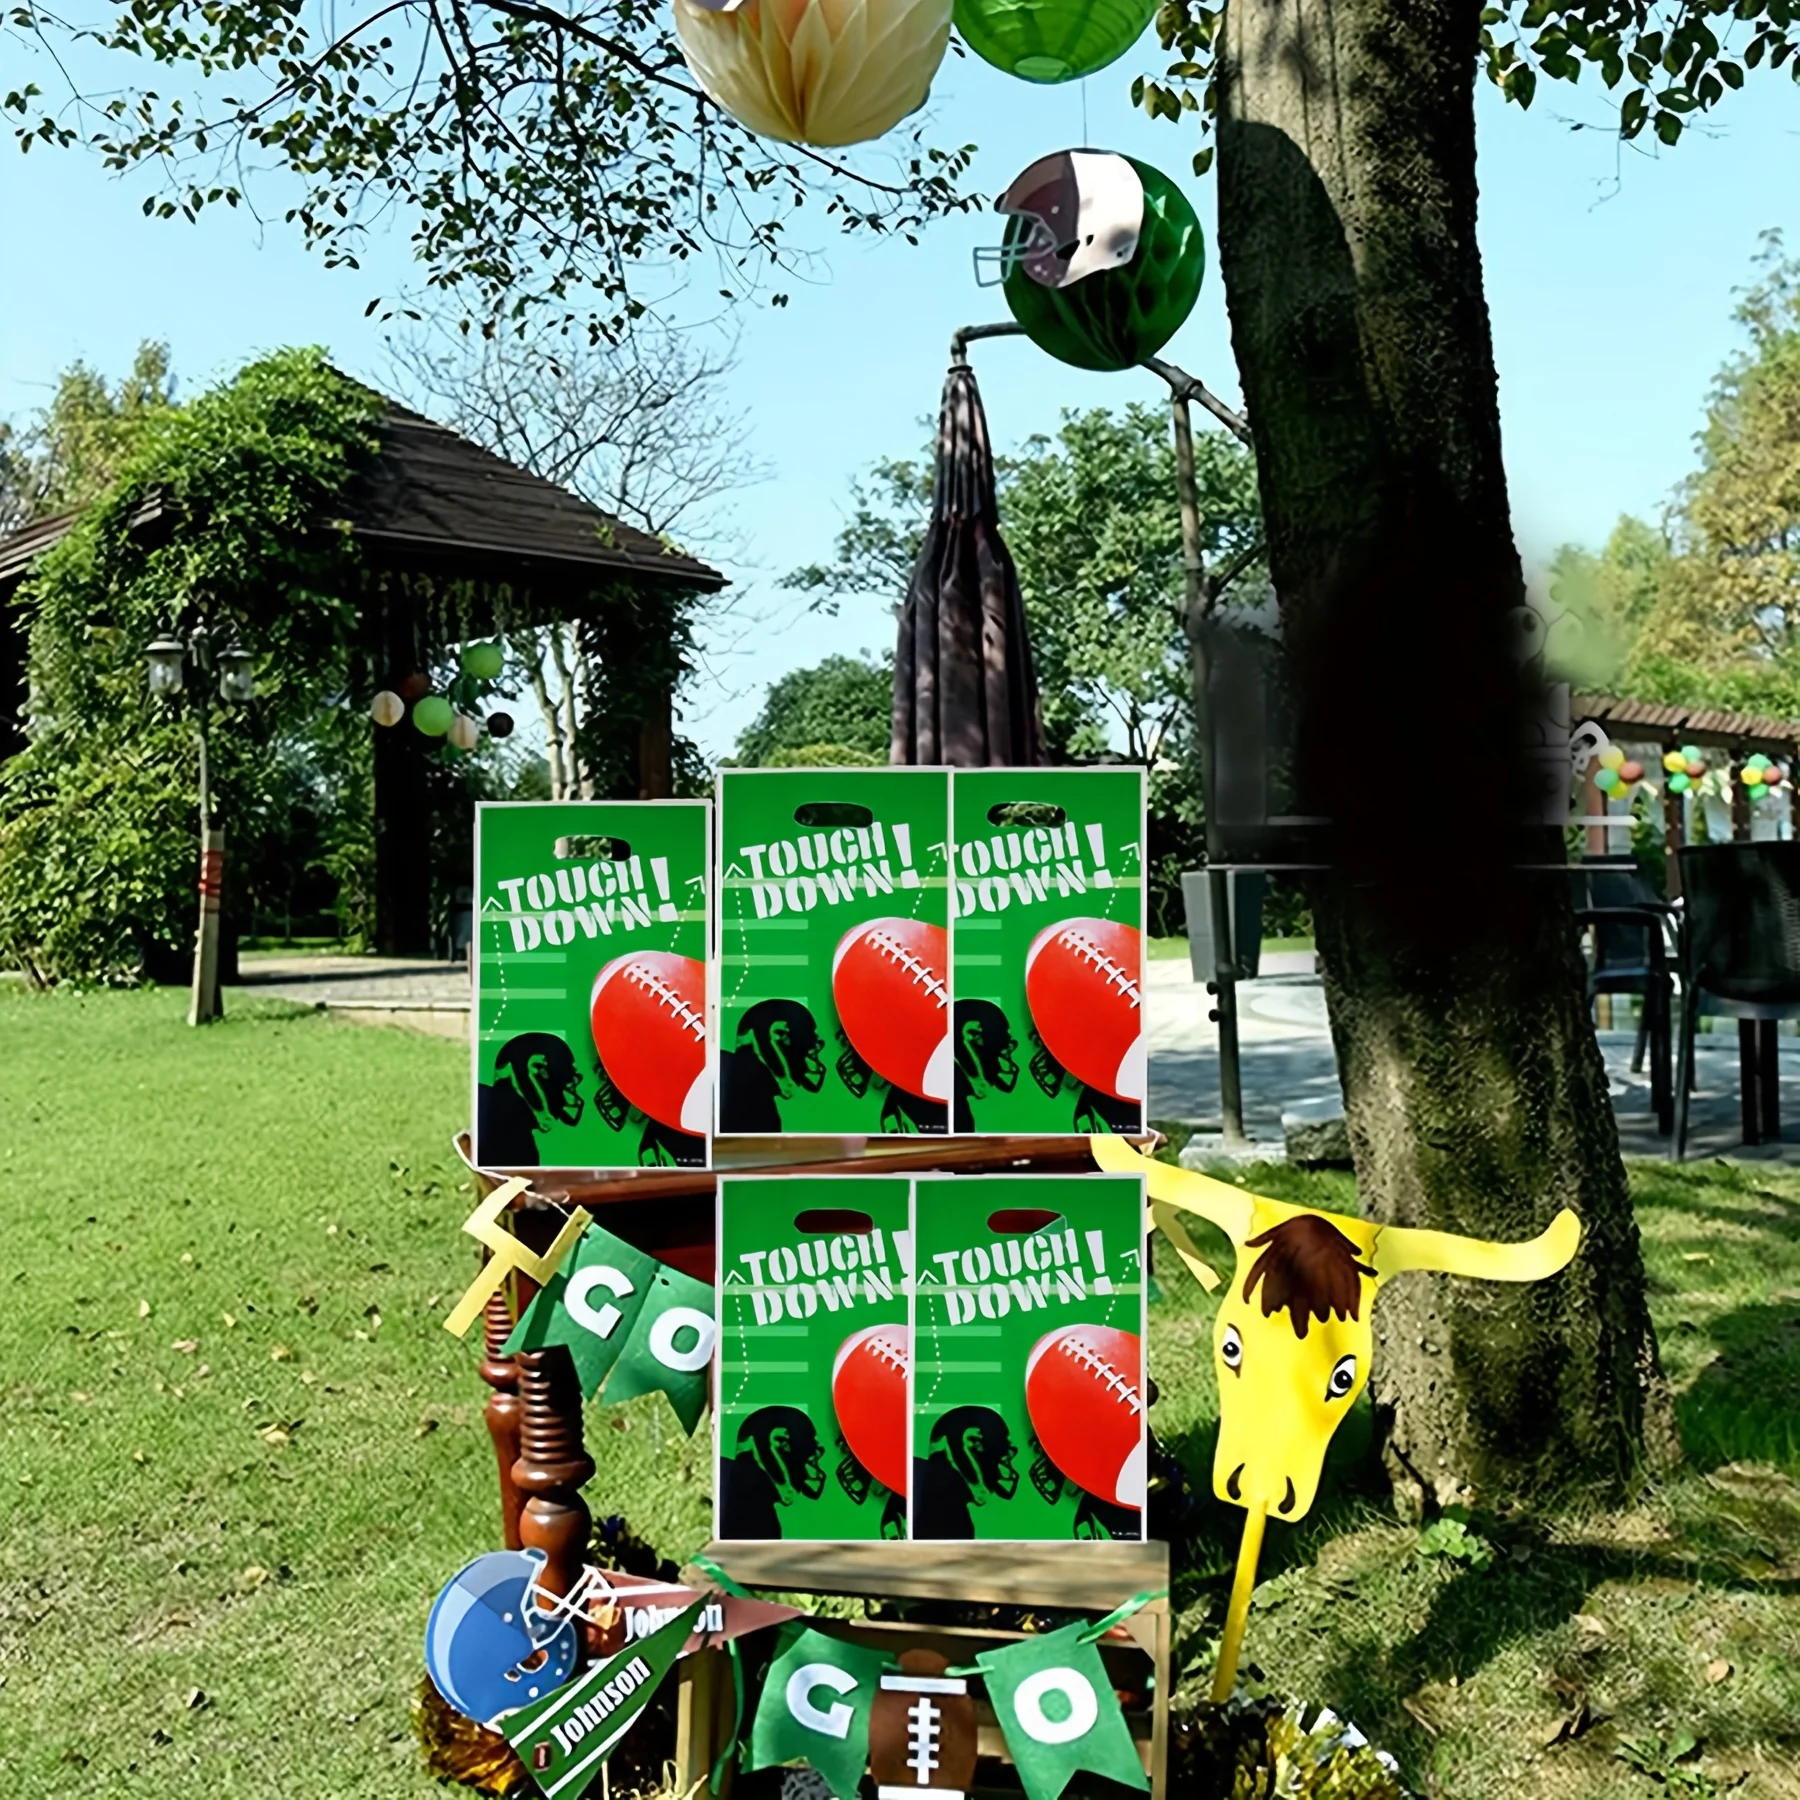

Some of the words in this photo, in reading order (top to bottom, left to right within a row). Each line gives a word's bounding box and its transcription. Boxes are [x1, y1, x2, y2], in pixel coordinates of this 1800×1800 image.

[740, 822, 886, 880] TOUCH
[953, 822, 1079, 880] OUCH
[498, 855, 644, 914] TOUCH
[740, 1229, 886, 1287] TOUCH
[933, 1229, 1079, 1287] TOUCH
[550, 1656, 651, 1757] Johnson
